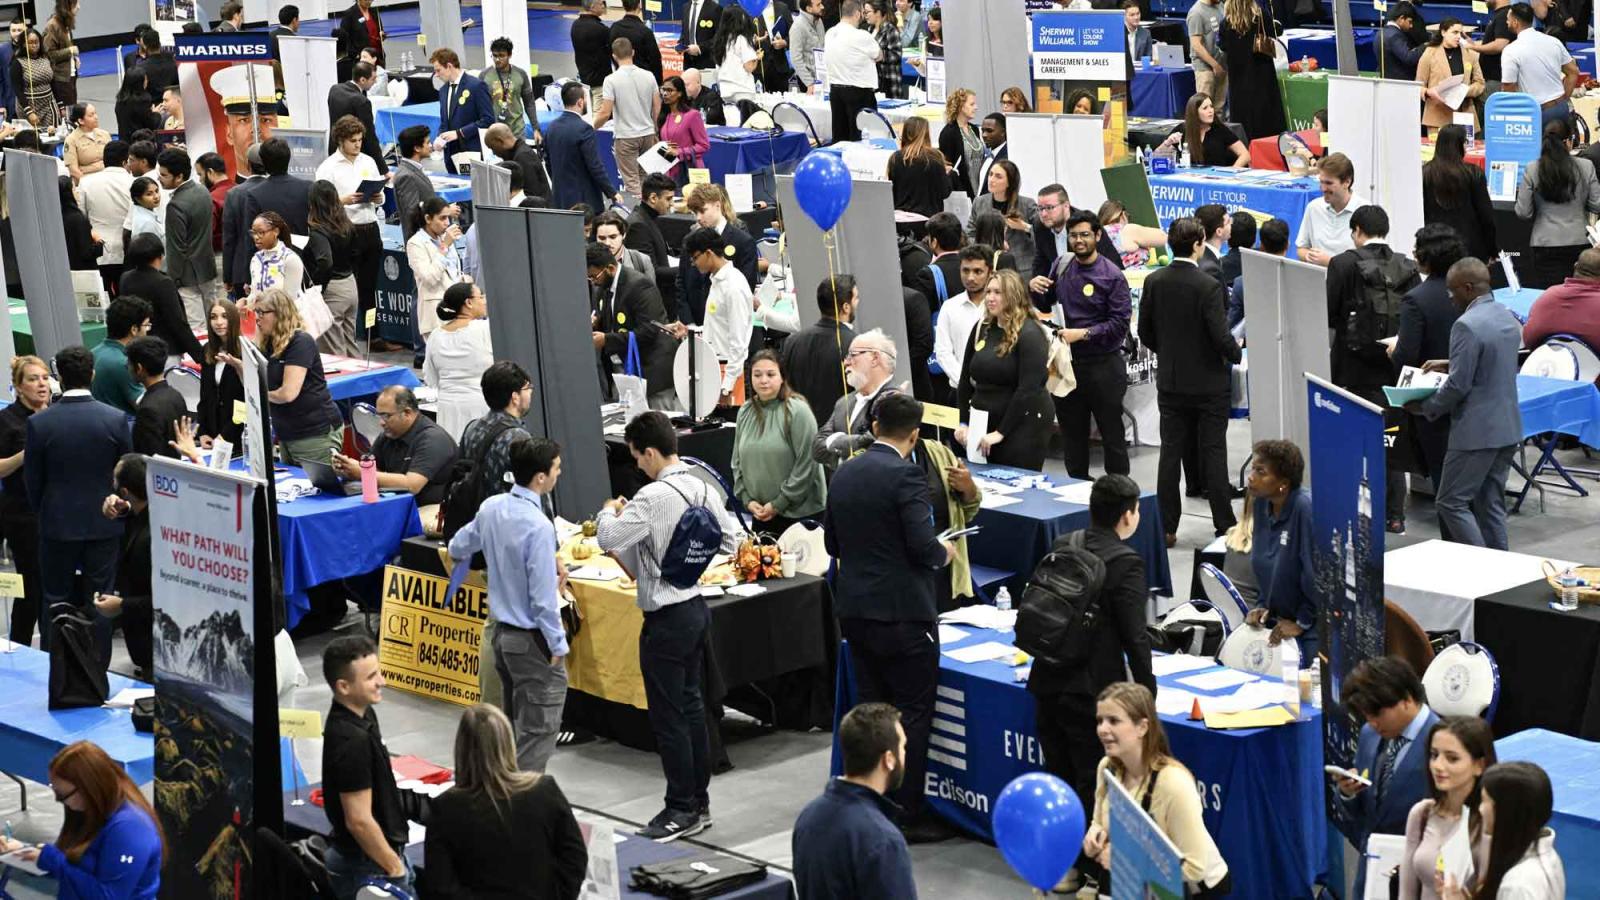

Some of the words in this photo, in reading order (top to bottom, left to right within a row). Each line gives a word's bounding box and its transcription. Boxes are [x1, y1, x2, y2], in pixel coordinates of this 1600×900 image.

[1040, 26, 1075, 36] SHERWIN
[178, 45, 267, 56] MARINES
[662, 60, 683, 71] wca
[1040, 58, 1084, 66] MANAGEMENT
[1086, 58, 1090, 66] &
[1041, 66, 1066, 74] CAREERS
[1505, 123, 1533, 136] RSM
[1150, 186, 1194, 202] ERWIN
[1209, 190, 1224, 201] LET
[1224, 191, 1247, 203] YOUR
[1157, 203, 1195, 220] LIAMS
[387, 291, 413, 313] WOR
[1383, 434, 1397, 448] EY
[154, 474, 179, 494] BDO
[160, 526, 191, 546] WHAT
[194, 535, 221, 555] PATH
[222, 542, 249, 563] WILL
[689, 540, 704, 549] Yale
[171, 550, 195, 569] YOU
[198, 557, 249, 584] CHOOSE?
[388, 614, 409, 637] CR
[419, 616, 480, 647] Propertie
[416, 640, 480, 677] (845)485-310
[924, 771, 989, 813] Edison
[1197, 780, 1222, 812] RS
